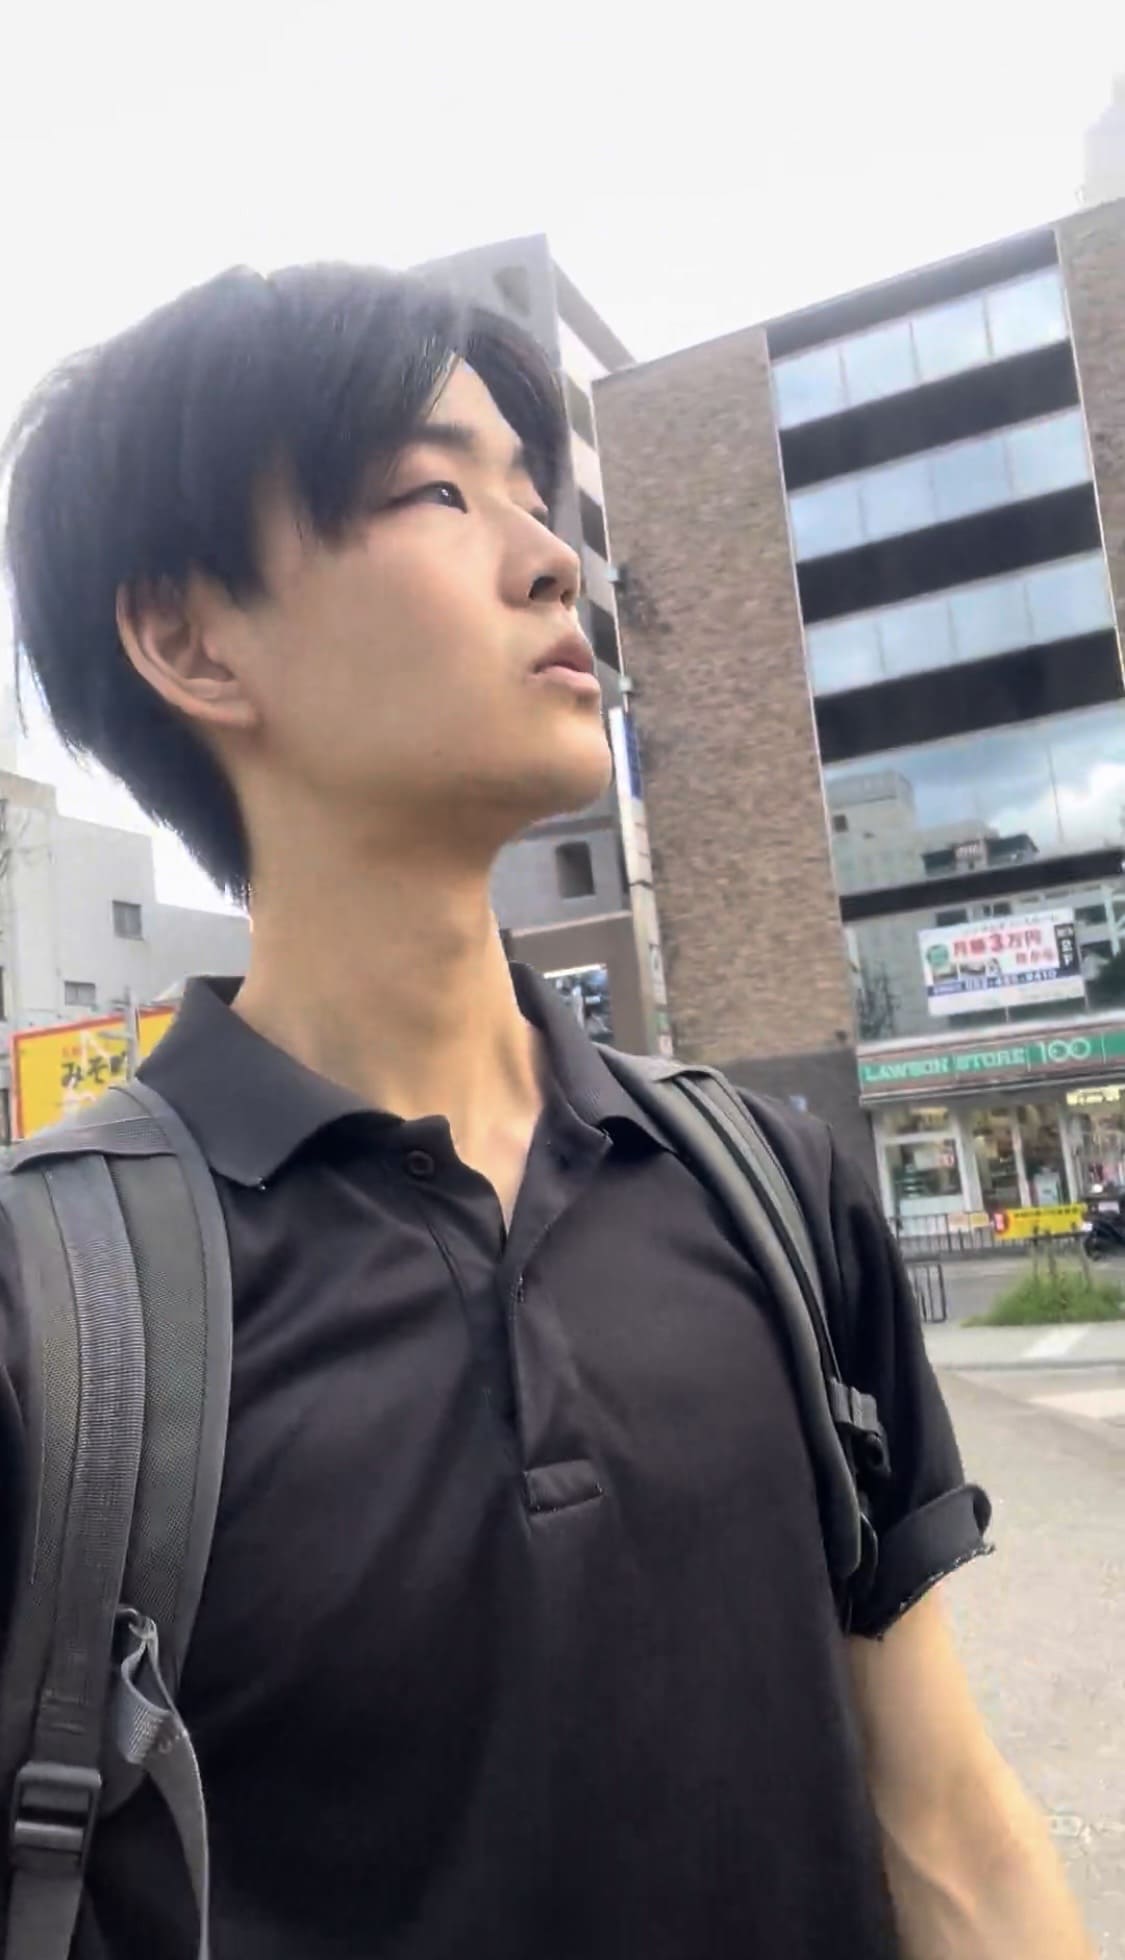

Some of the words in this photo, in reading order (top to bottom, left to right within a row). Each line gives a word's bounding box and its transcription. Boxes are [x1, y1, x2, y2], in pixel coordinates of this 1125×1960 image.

[865, 1059, 949, 1082] LAWSON
[955, 1048, 1026, 1071] STORE
[1038, 1039, 1090, 1063] 100
